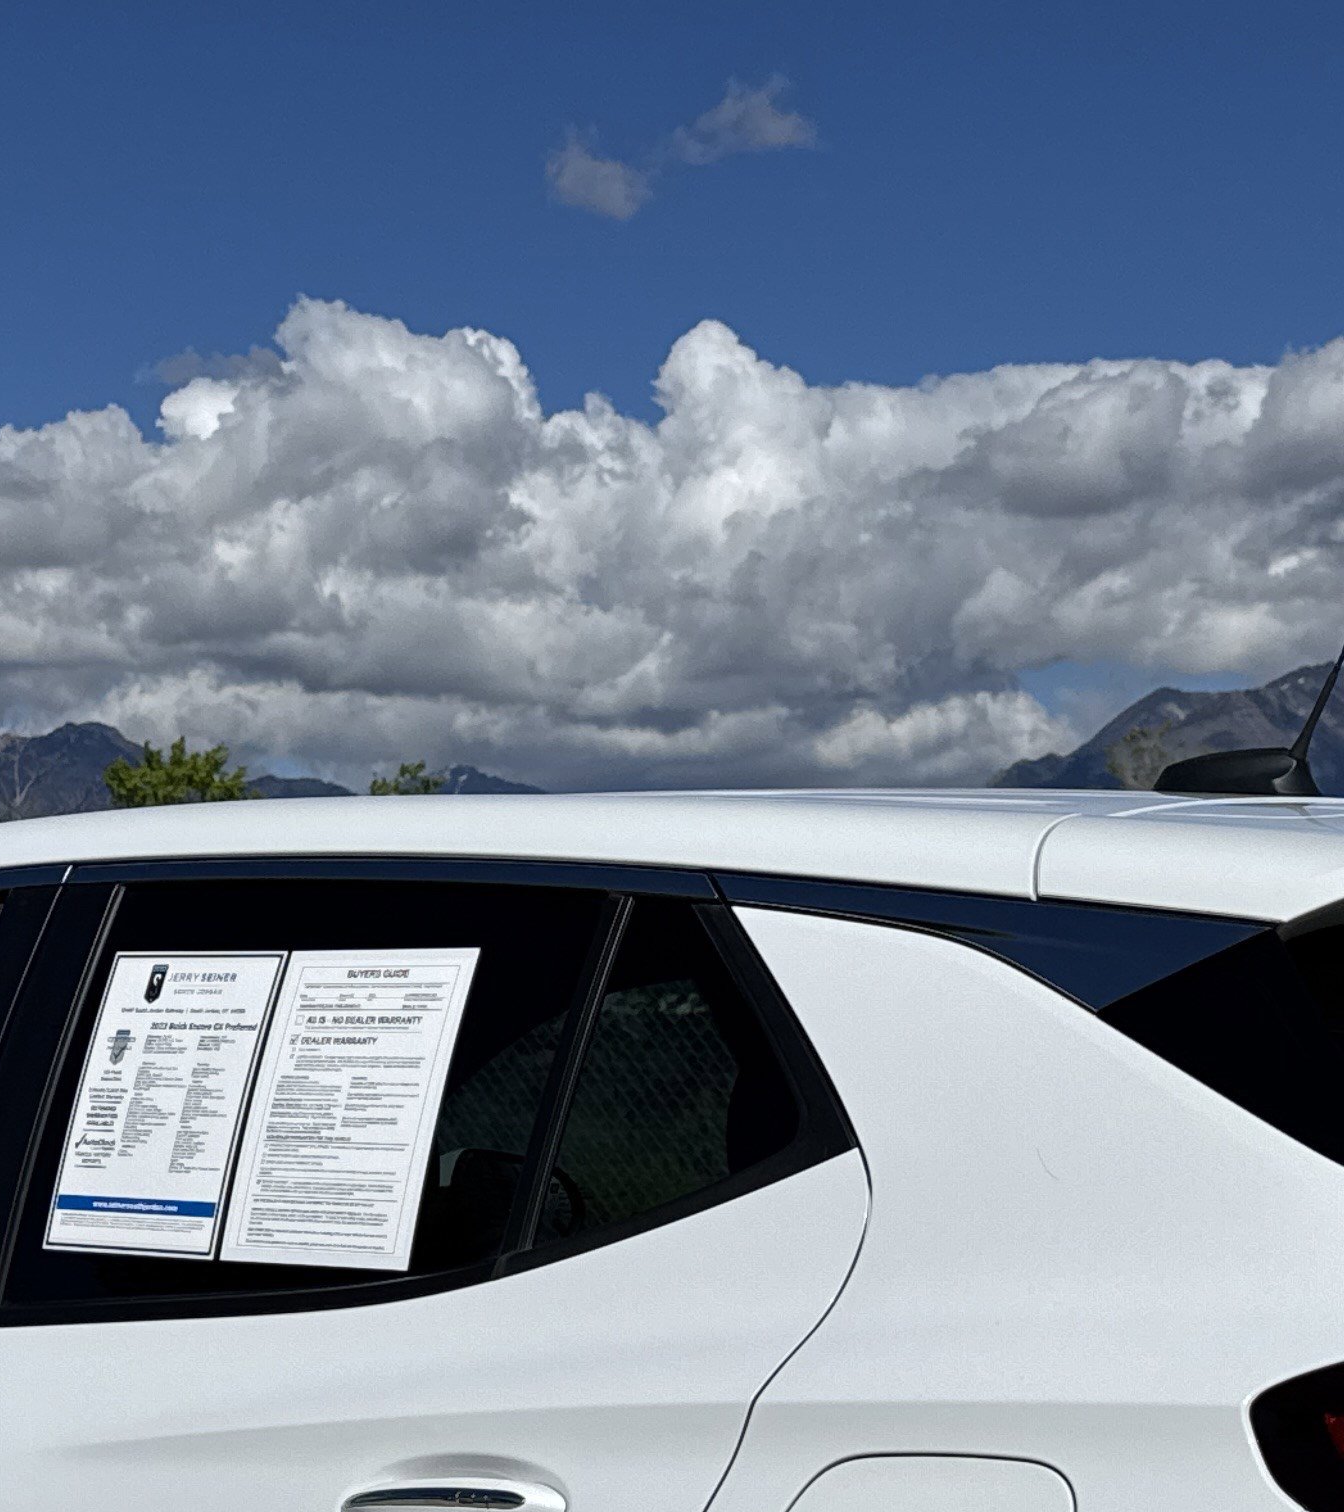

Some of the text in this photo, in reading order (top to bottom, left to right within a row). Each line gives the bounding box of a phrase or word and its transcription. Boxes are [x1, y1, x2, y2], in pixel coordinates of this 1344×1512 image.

[168, 972, 237, 982] JERRY SEINER
[378, 1016, 423, 1025] WARRANTY
[301, 1037, 378, 1046] DEALER WARRANTY
